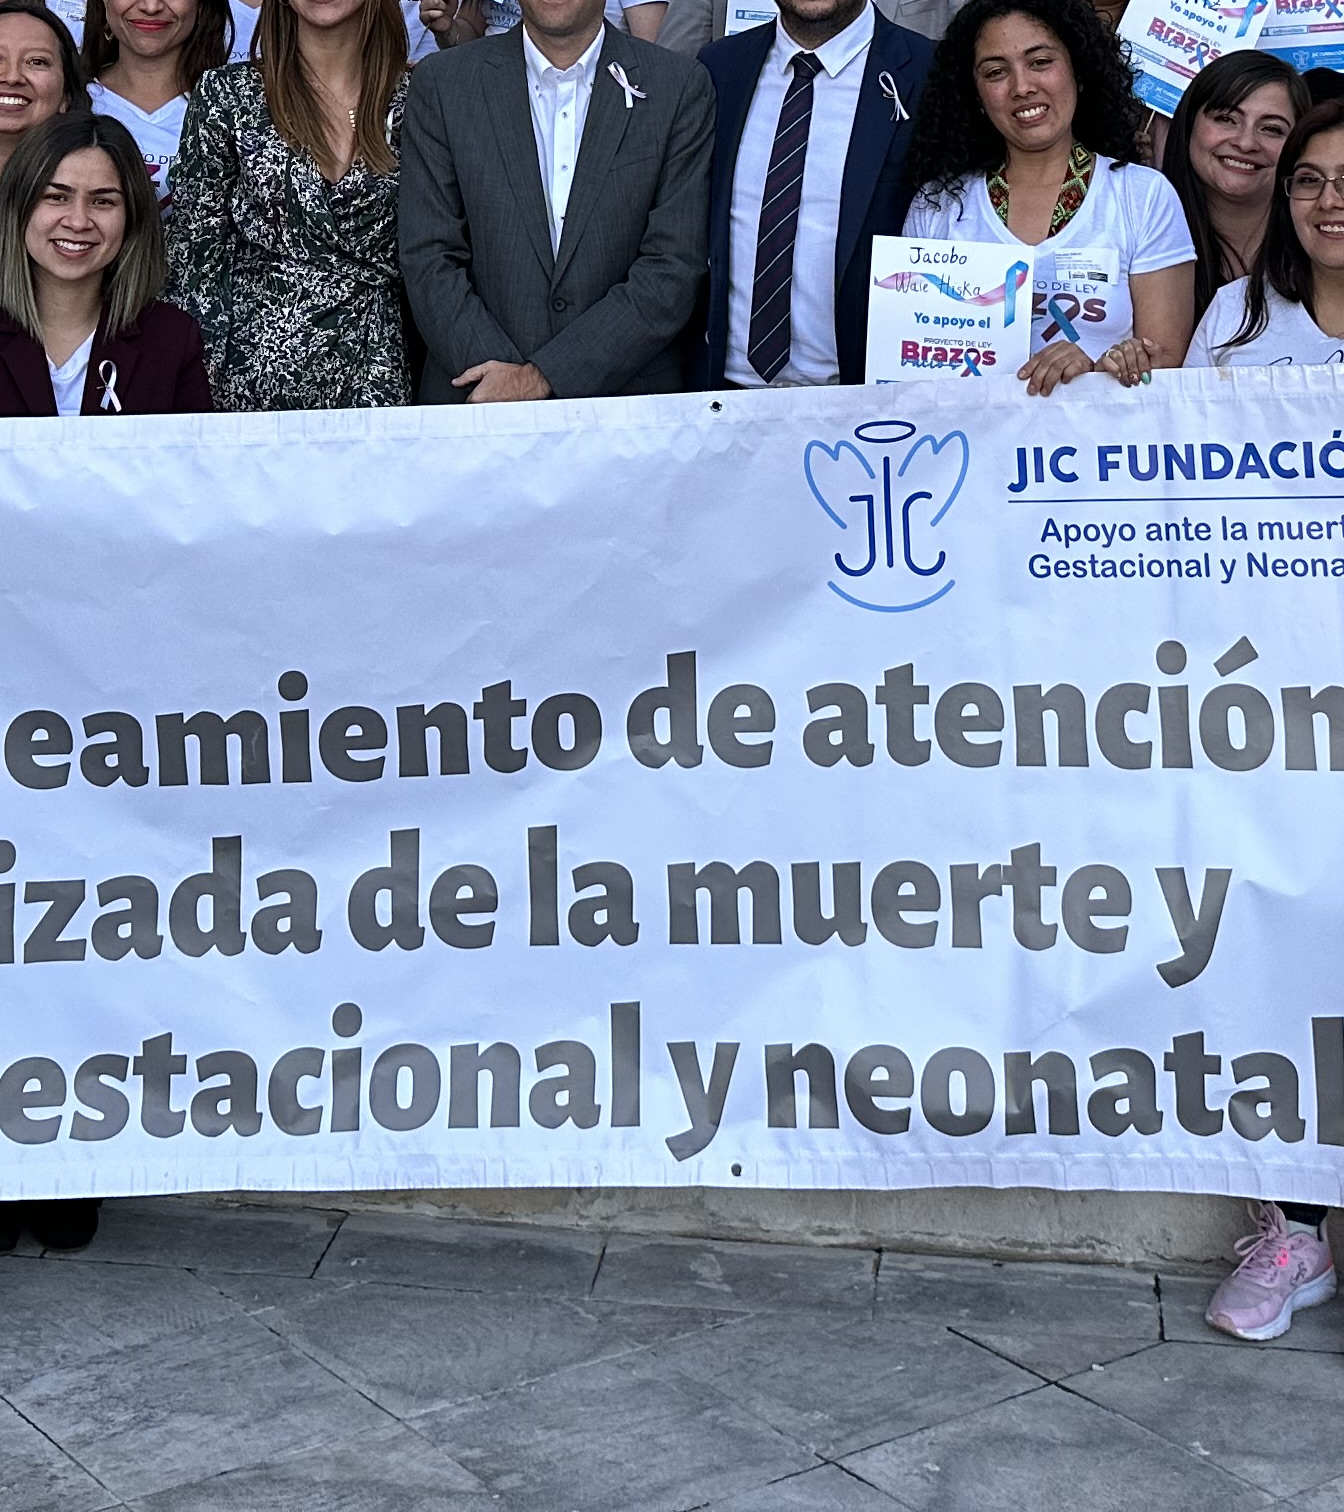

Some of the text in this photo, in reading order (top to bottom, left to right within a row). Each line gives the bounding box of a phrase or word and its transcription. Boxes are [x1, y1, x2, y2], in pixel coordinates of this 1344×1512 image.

[1170, 0, 1227, 33] Yo apoyo el
[909, 246, 968, 265] Jacobo
[1051, 281, 1098, 295] DE LEY
[914, 312, 991, 329] Yo apoyo el
[901, 340, 996, 366] Brazos
[1007, 446, 1078, 493] JIC
[1040, 517, 1136, 549] Apoyo
[1145, 516, 1212, 543] ante
[1221, 516, 1249, 543] la
[1027, 552, 1211, 581] Gestacional
[1219, 556, 1238, 585] y
[626, 650, 777, 770] de
[347, 827, 498, 954] de
[527, 823, 639, 949] la
[667, 841, 1132, 955] muerte
[1154, 866, 1233, 989] y
[664, 1040, 740, 1163] y
